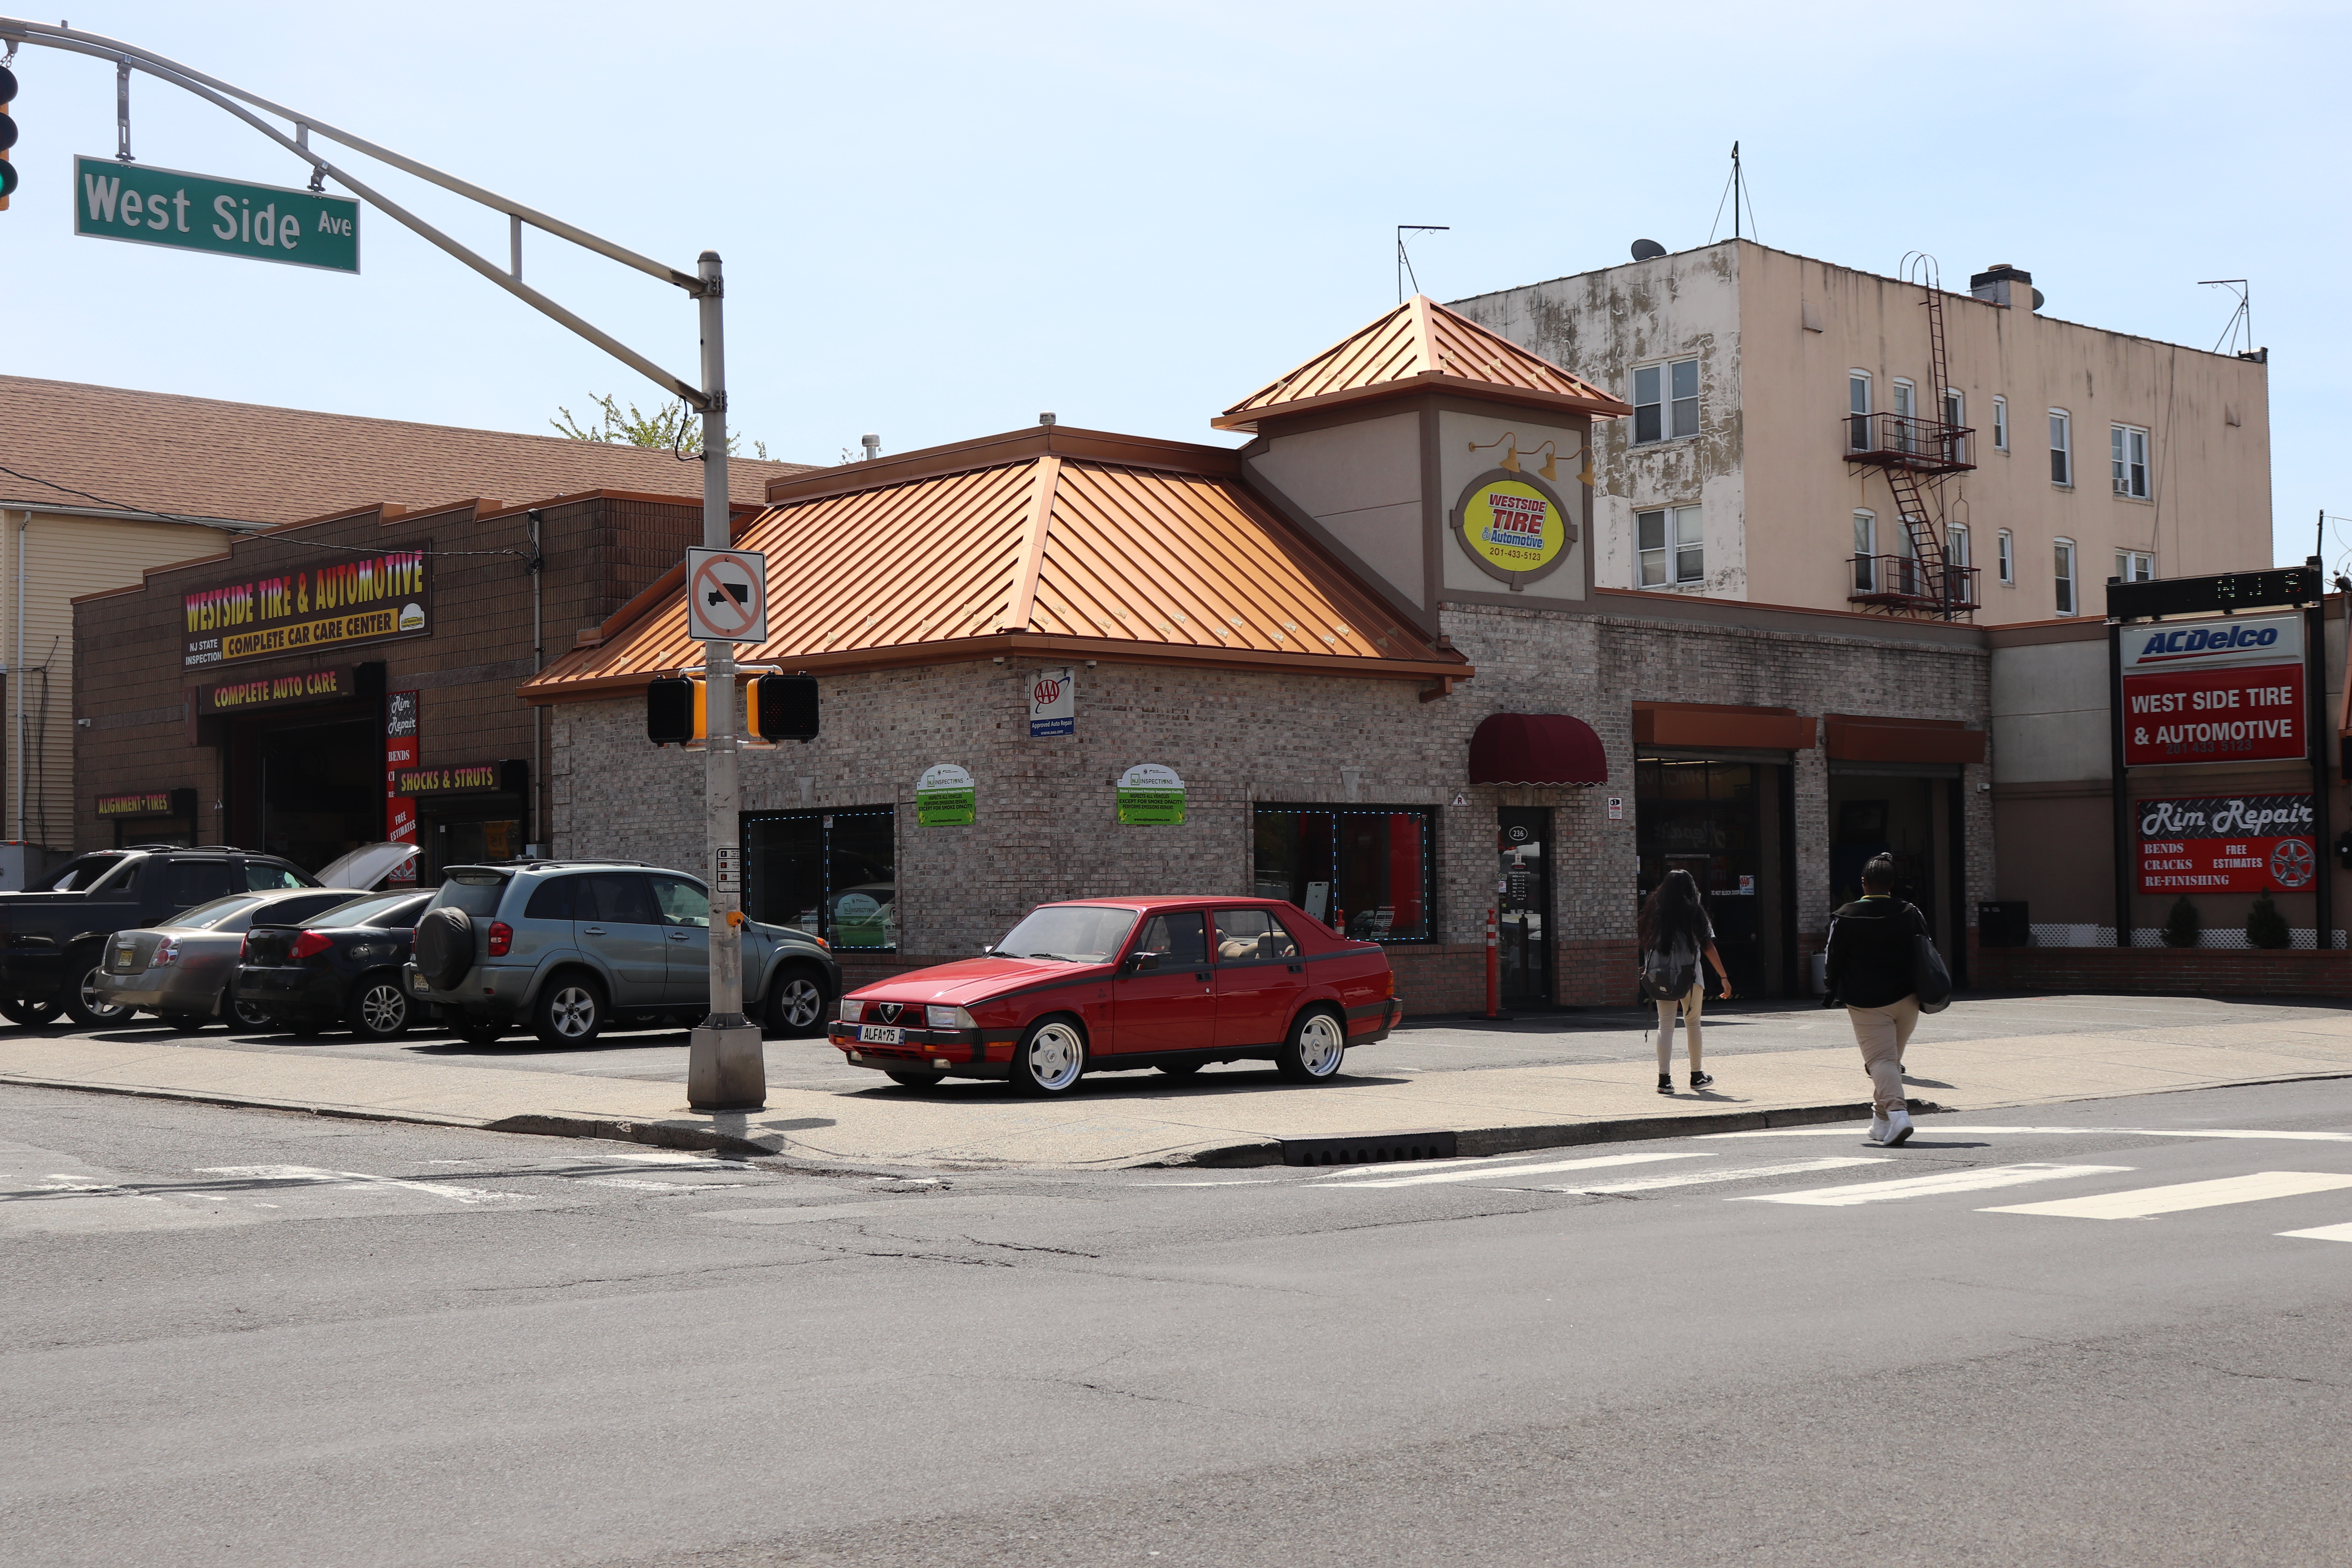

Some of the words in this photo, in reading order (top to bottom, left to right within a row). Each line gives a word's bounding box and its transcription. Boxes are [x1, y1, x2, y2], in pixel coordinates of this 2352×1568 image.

[85, 174, 190, 233] West
[213, 195, 299, 249] Side
[318, 211, 352, 236] Ave
[1490, 494, 1546, 512] WESTSIDE
[1492, 510, 1544, 535] TIRE
[1482, 527, 1490, 540] &
[1490, 530, 1543, 548] Automotive
[1490, 548, 1541, 561] 201-433-5123
[186, 583, 253, 633] WESTSIDE
[259, 576, 292, 620] TIRE
[297, 572, 309, 613] &
[316, 550, 423, 611] AUTOMOTIVE
[228, 630, 285, 655] COMPLETE
[288, 626, 309, 645] CAR
[314, 621, 342, 641] CARE
[347, 613, 392, 636] CENTER
[2142, 626, 2278, 654] ACDelco
[190, 642, 198, 652] NJ
[199, 639, 218, 650] STATE
[185, 651, 222, 666] INSPECTION
[214, 681, 269, 708] COMPLETE
[273, 676, 303, 699] AUTO
[306, 671, 337, 694] CARE
[1034, 680, 1059, 704] AAA
[391, 696, 410, 714] Rim
[2132, 693, 2187, 714] WEST
[2193, 690, 2239, 710] SIDE
[2246, 686, 2292, 706] TIRE
[388, 717, 416, 735] Repair
[1061, 720, 1073, 728] Repair
[2134, 727, 2149, 745] &
[2156, 719, 2292, 744] AUTOMOTIVE
[388, 750, 410, 762] BENDS
[2166, 743, 2188, 755] 201
[2193, 741, 2215, 753] 433
[2221, 739, 2252, 751] 5123
[401, 771, 439, 792] SHOCKS
[443, 770, 450, 788] &
[455, 767, 493, 788] STRUTS
[99, 795, 142, 815] ALIGNMENT
[145, 794, 167, 811] TIRES
[395, 811, 407, 826] FREE
[2142, 803, 2206, 835] Rim
[2213, 800, 2313, 836] Repair
[390, 820, 416, 842] ESTIMATES
[2144, 844, 2183, 854] BENDS
[2226, 845, 2247, 855] FREE
[2145, 859, 2192, 870] CRACKS
[2213, 858, 2263, 869] ESTIMATES
[1740, 877, 1749, 886] AAA
[2145, 875, 2229, 886] RE-FINISHING
[864, 1028, 882, 1041] ALFA
[886, 1030, 895, 1041] 75
